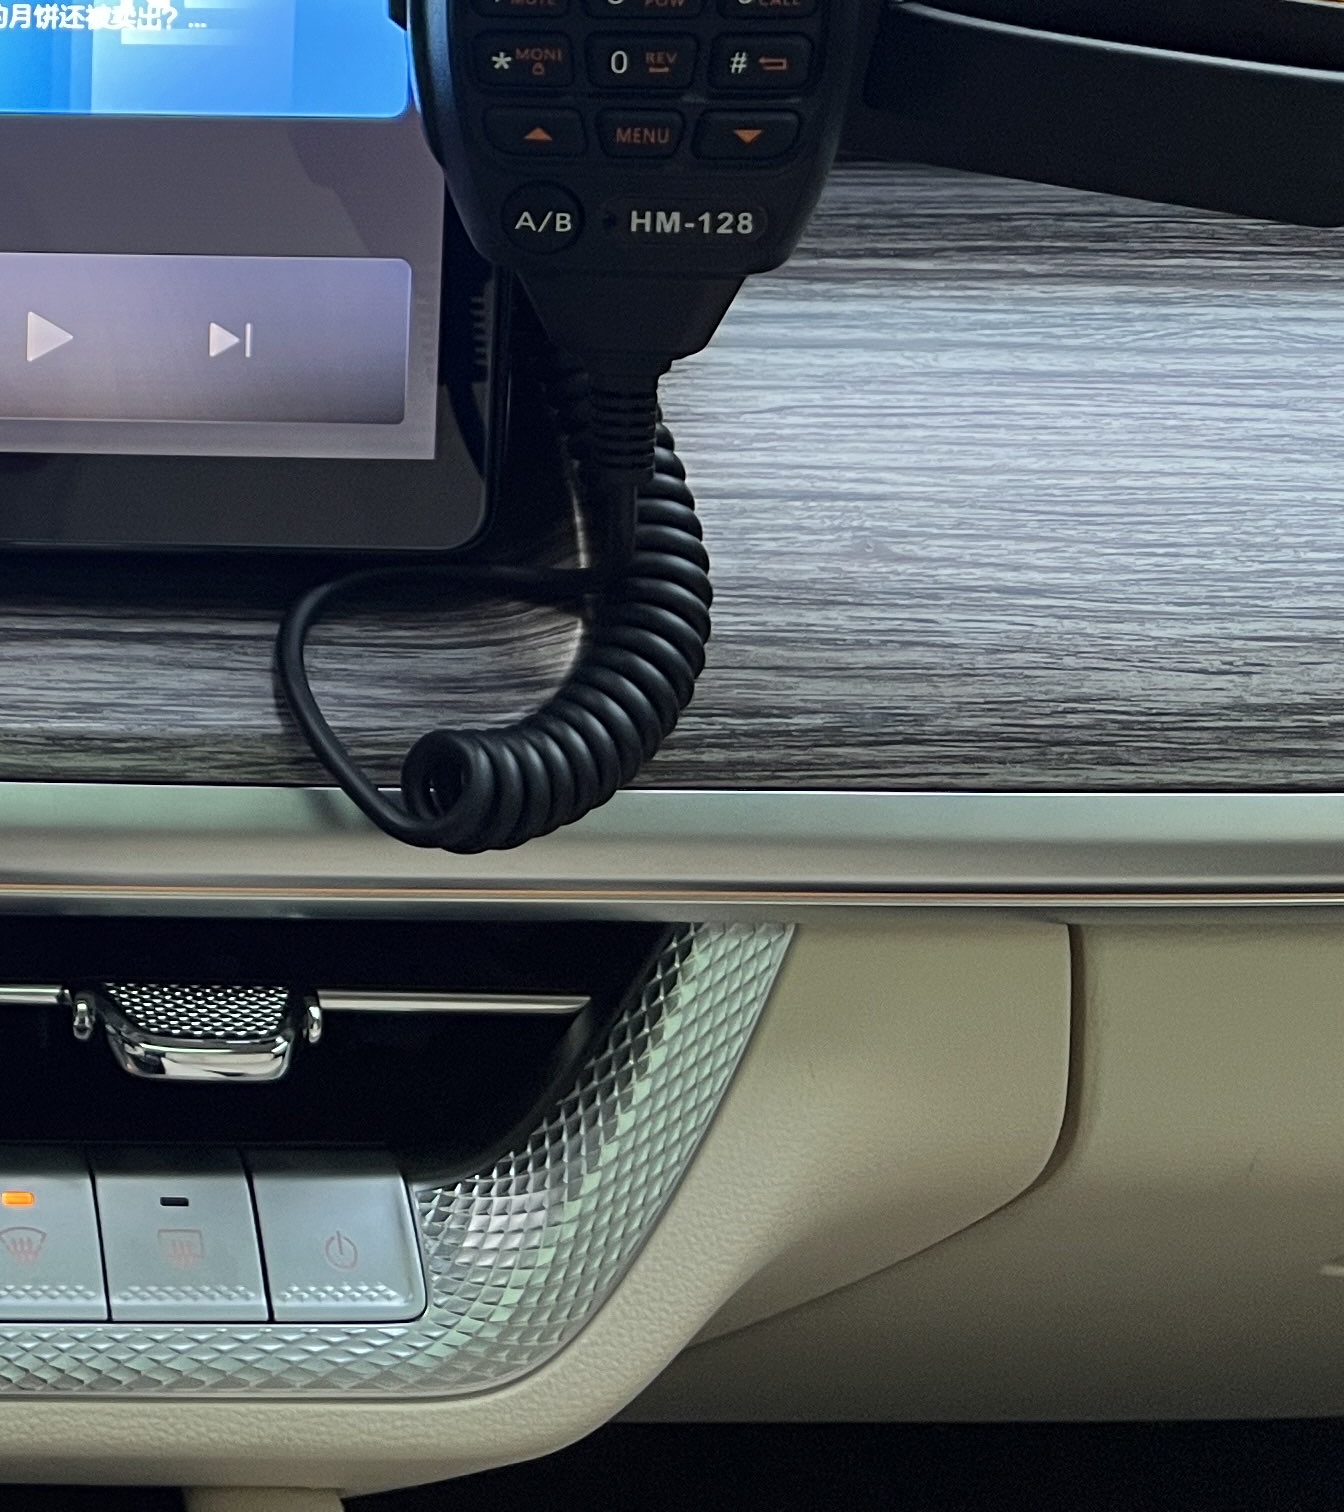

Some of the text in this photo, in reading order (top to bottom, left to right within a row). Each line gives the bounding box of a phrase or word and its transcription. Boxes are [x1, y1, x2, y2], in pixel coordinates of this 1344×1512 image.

[610, 51, 677, 74] 0 REV
[616, 127, 670, 144] MENU
[515, 210, 754, 234] A/B HM-128
